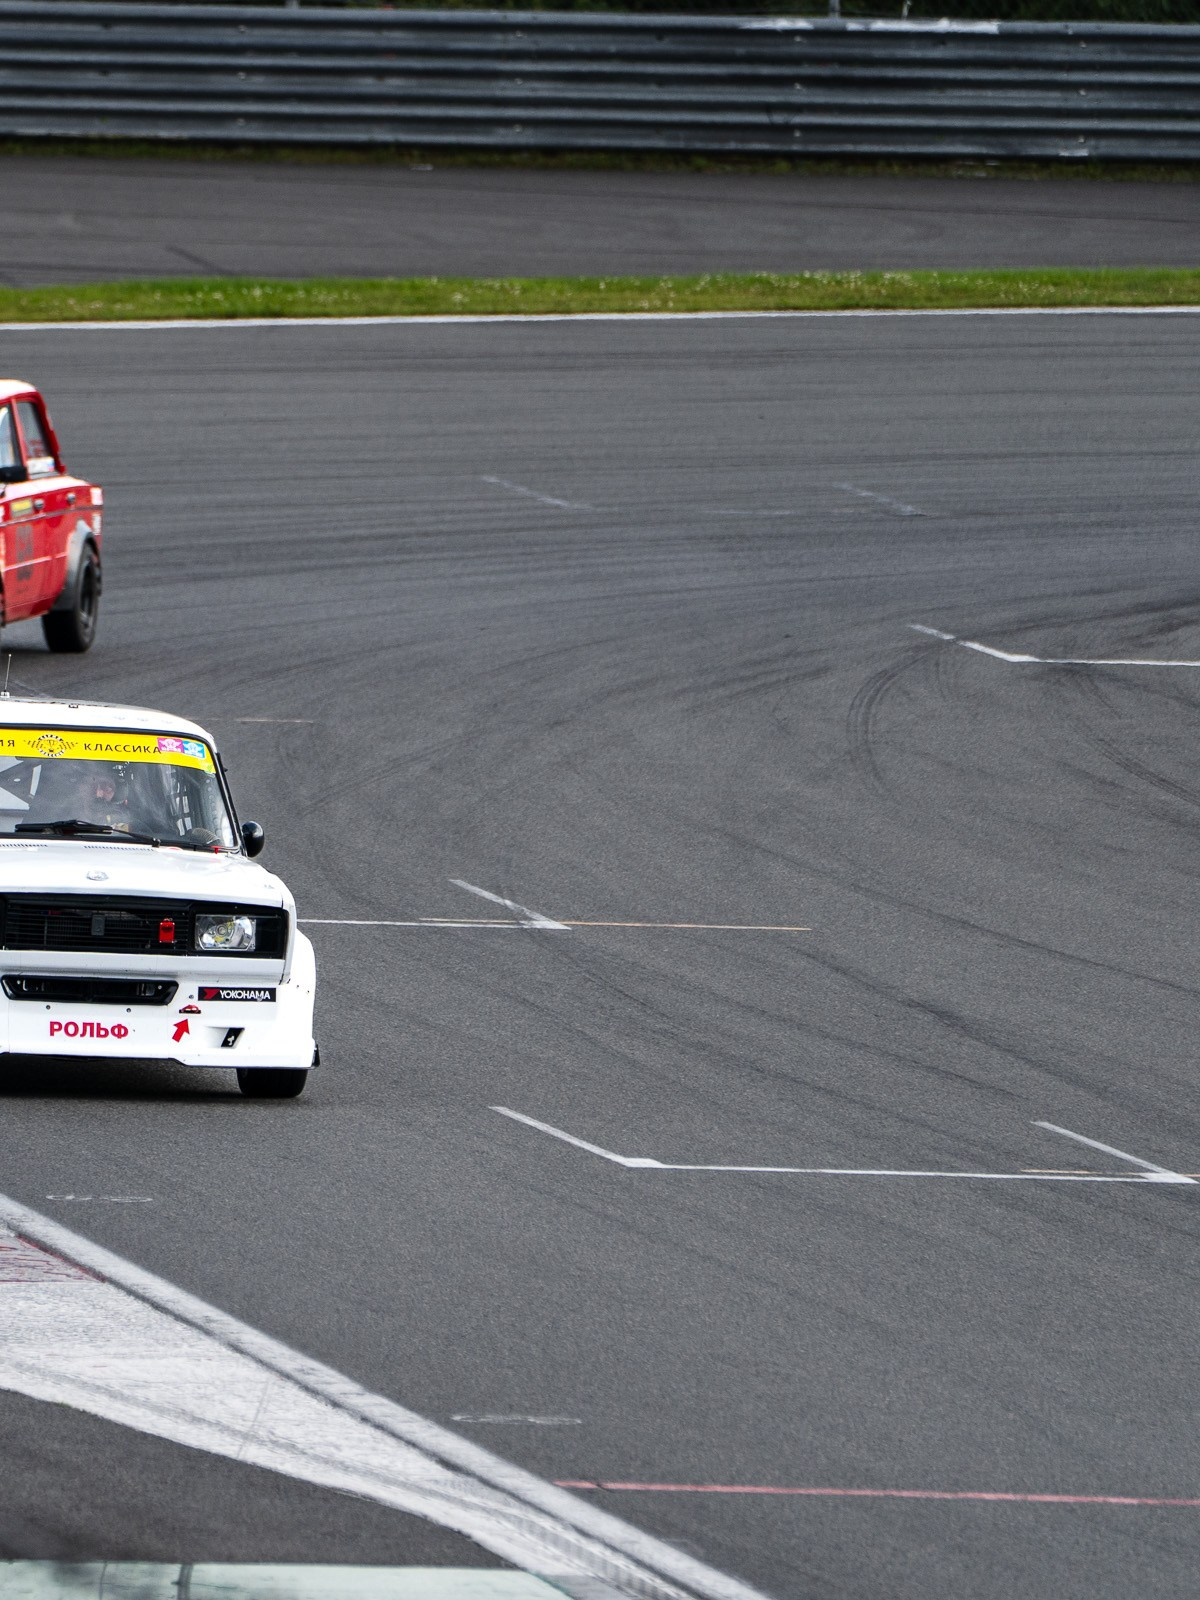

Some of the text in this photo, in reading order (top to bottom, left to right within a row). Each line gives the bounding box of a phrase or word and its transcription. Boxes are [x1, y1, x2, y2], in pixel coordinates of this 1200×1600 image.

[84, 743, 161, 754] КЛАССИКА
[220, 990, 271, 1000] YOKOHAMA
[49, 1021, 128, 1039] РОЛЬФ
